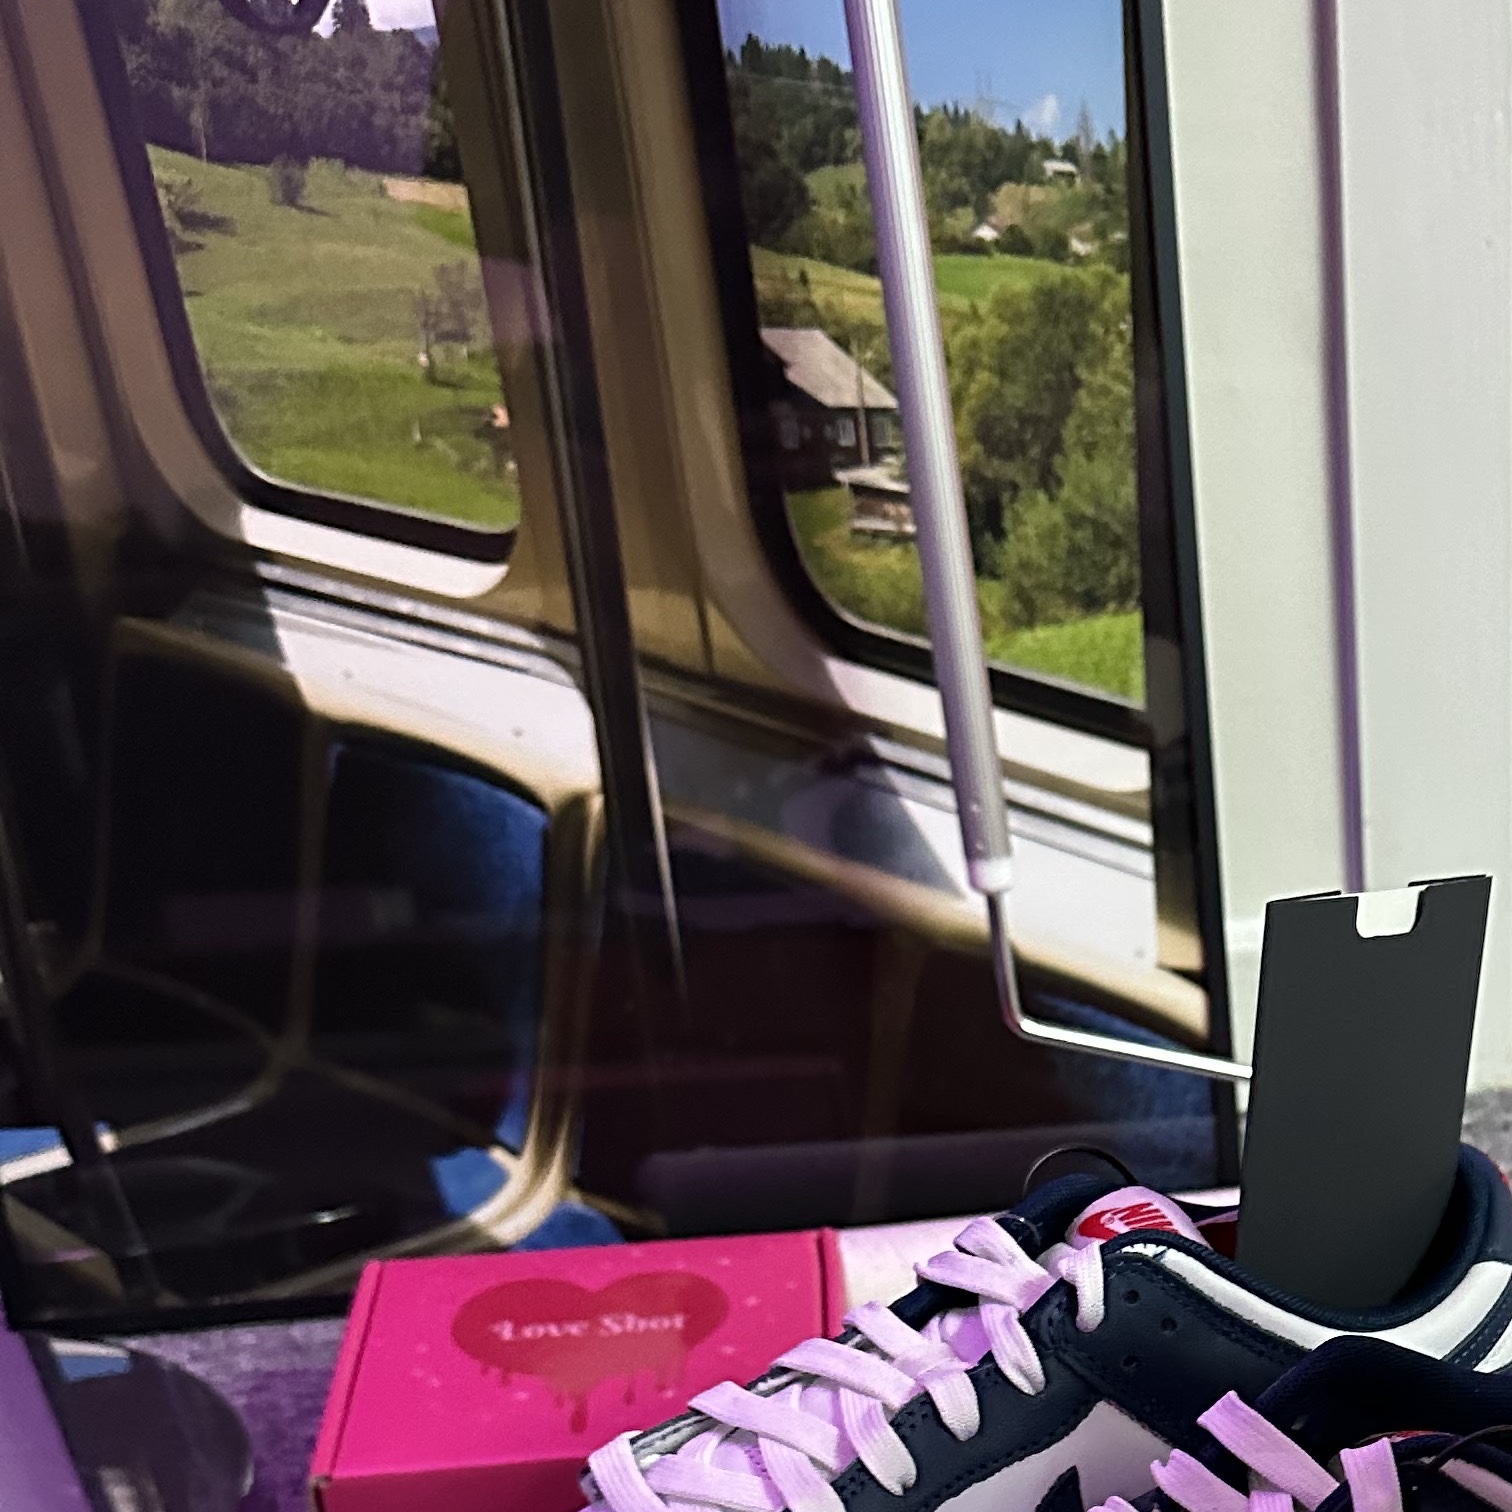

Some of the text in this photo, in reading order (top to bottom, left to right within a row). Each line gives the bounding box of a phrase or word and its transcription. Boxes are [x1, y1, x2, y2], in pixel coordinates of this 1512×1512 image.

[1111, 1201, 1180, 1235] NIK
[490, 1312, 686, 1341] Love Shot
